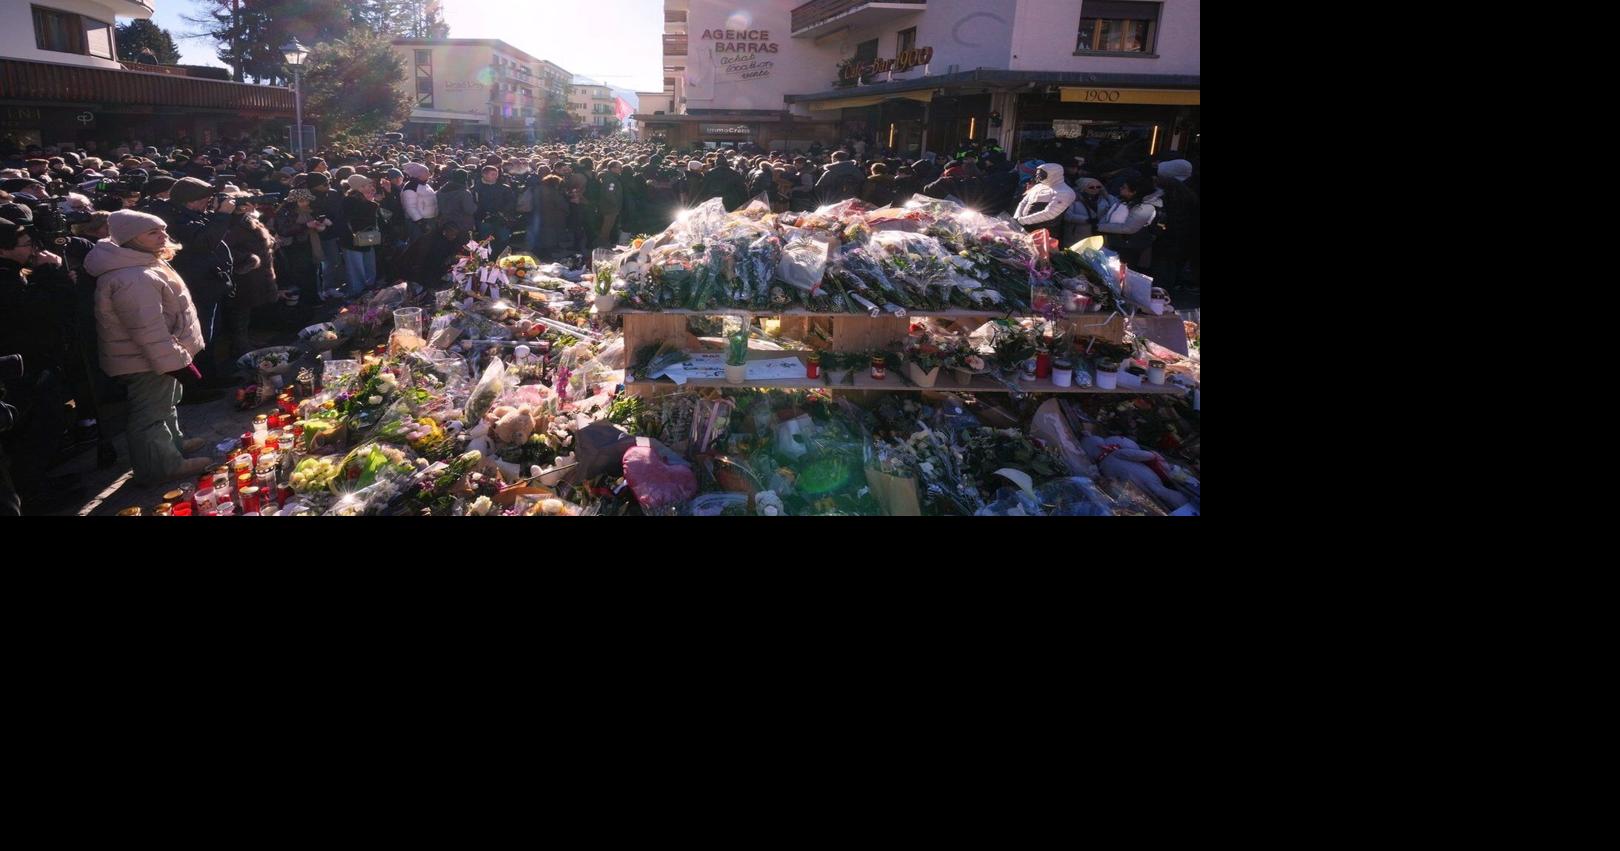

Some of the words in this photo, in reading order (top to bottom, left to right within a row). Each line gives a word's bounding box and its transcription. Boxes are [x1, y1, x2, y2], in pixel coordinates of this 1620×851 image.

[702, 29, 769, 40] AGENCE
[715, 42, 779, 53] BARRAS
[896, 47, 931, 71] 1900
[1085, 89, 1120, 102] 1900
